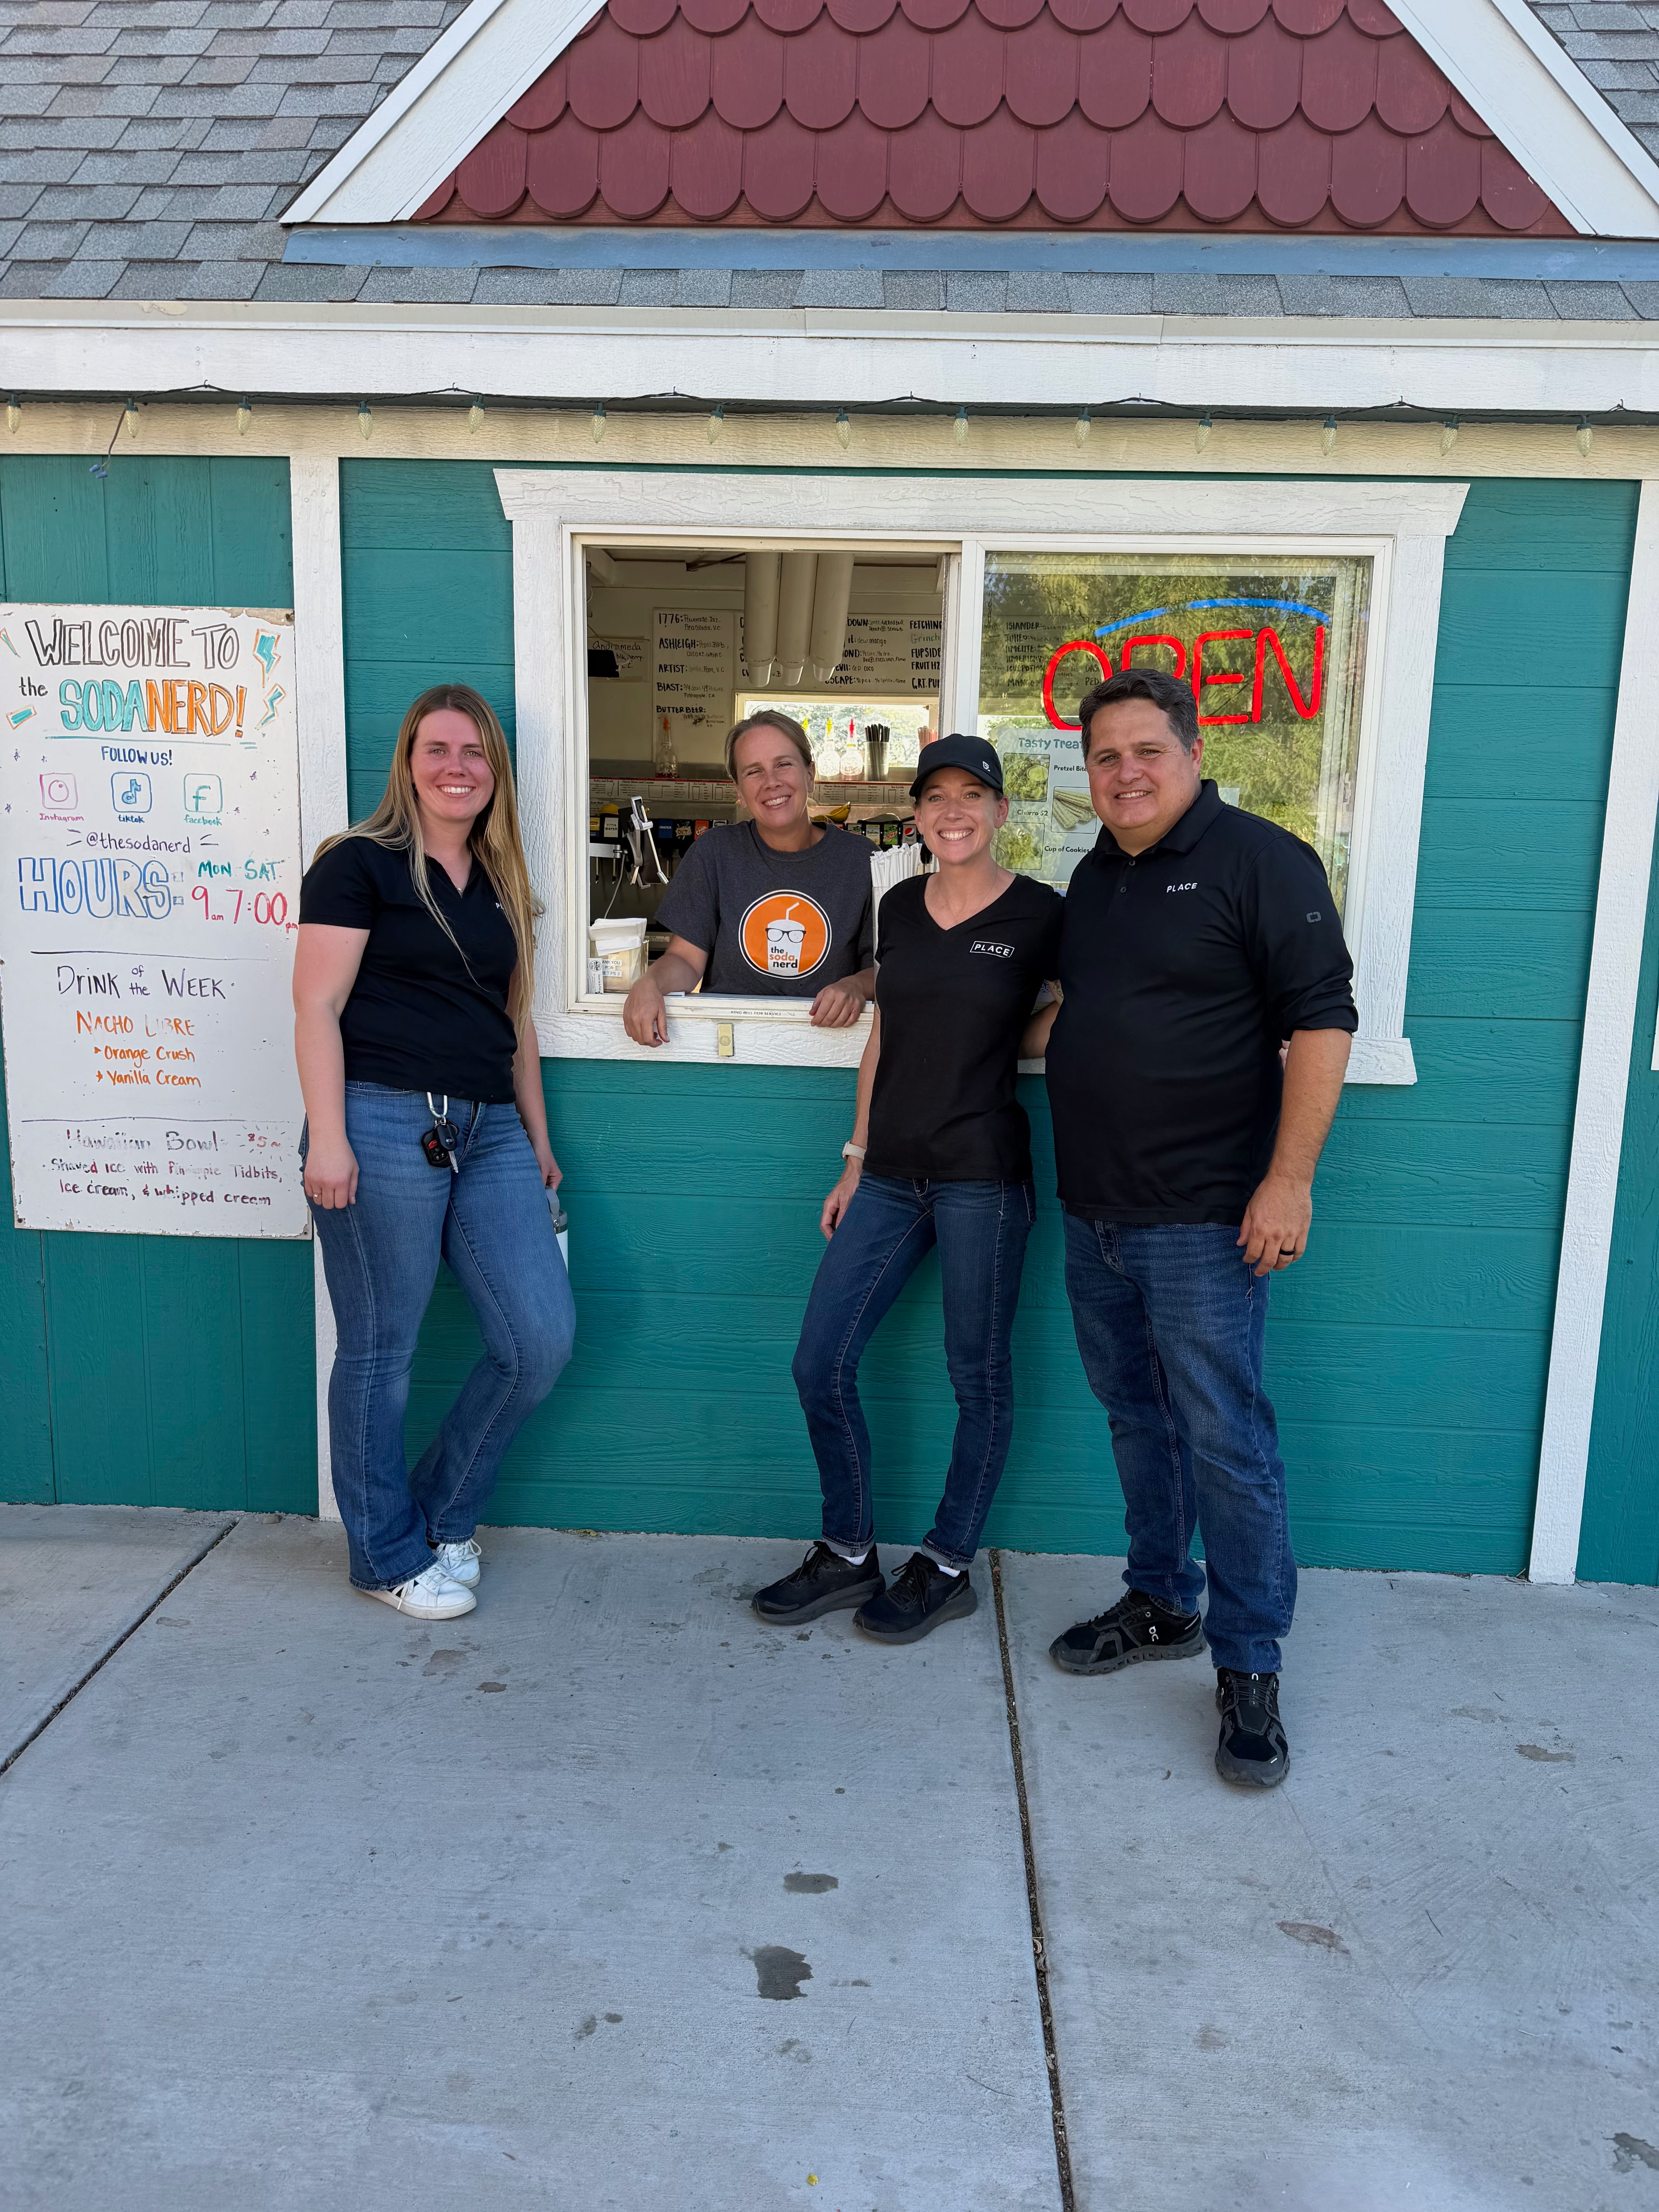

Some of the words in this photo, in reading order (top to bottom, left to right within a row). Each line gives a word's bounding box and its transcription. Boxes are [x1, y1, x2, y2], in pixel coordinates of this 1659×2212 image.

[25, 618, 191, 668] WELCOME
[191, 622, 240, 670] TO
[911, 632, 940, 644] Grinch
[843, 649, 862, 658] OND:
[1041, 626, 1325, 731] OPEN
[19, 676, 48, 697] the
[1018, 737, 1051, 750] Tasty
[101, 746, 148, 764] FOLLOW
[150, 749, 173, 766] US!
[40, 813, 85, 822] Instagram
[184, 814, 222, 826] facebook
[87, 831, 191, 854] @thesodanerd
[198, 859, 232, 878] MON
[1166, 883, 1198, 893] PLACE
[769, 951, 795, 961] soda
[974, 944, 1010, 956] PLACE
[773, 959, 798, 968] nerd
[132, 966, 144, 977] of
[129, 984, 151, 996] the
[104, 1046, 151, 1068] Orange
[156, 1046, 196, 1062] Crush
[108, 1069, 151, 1085] Vanilla
[156, 1071, 201, 1088] Cream
[134, 1161, 159, 1174] with
